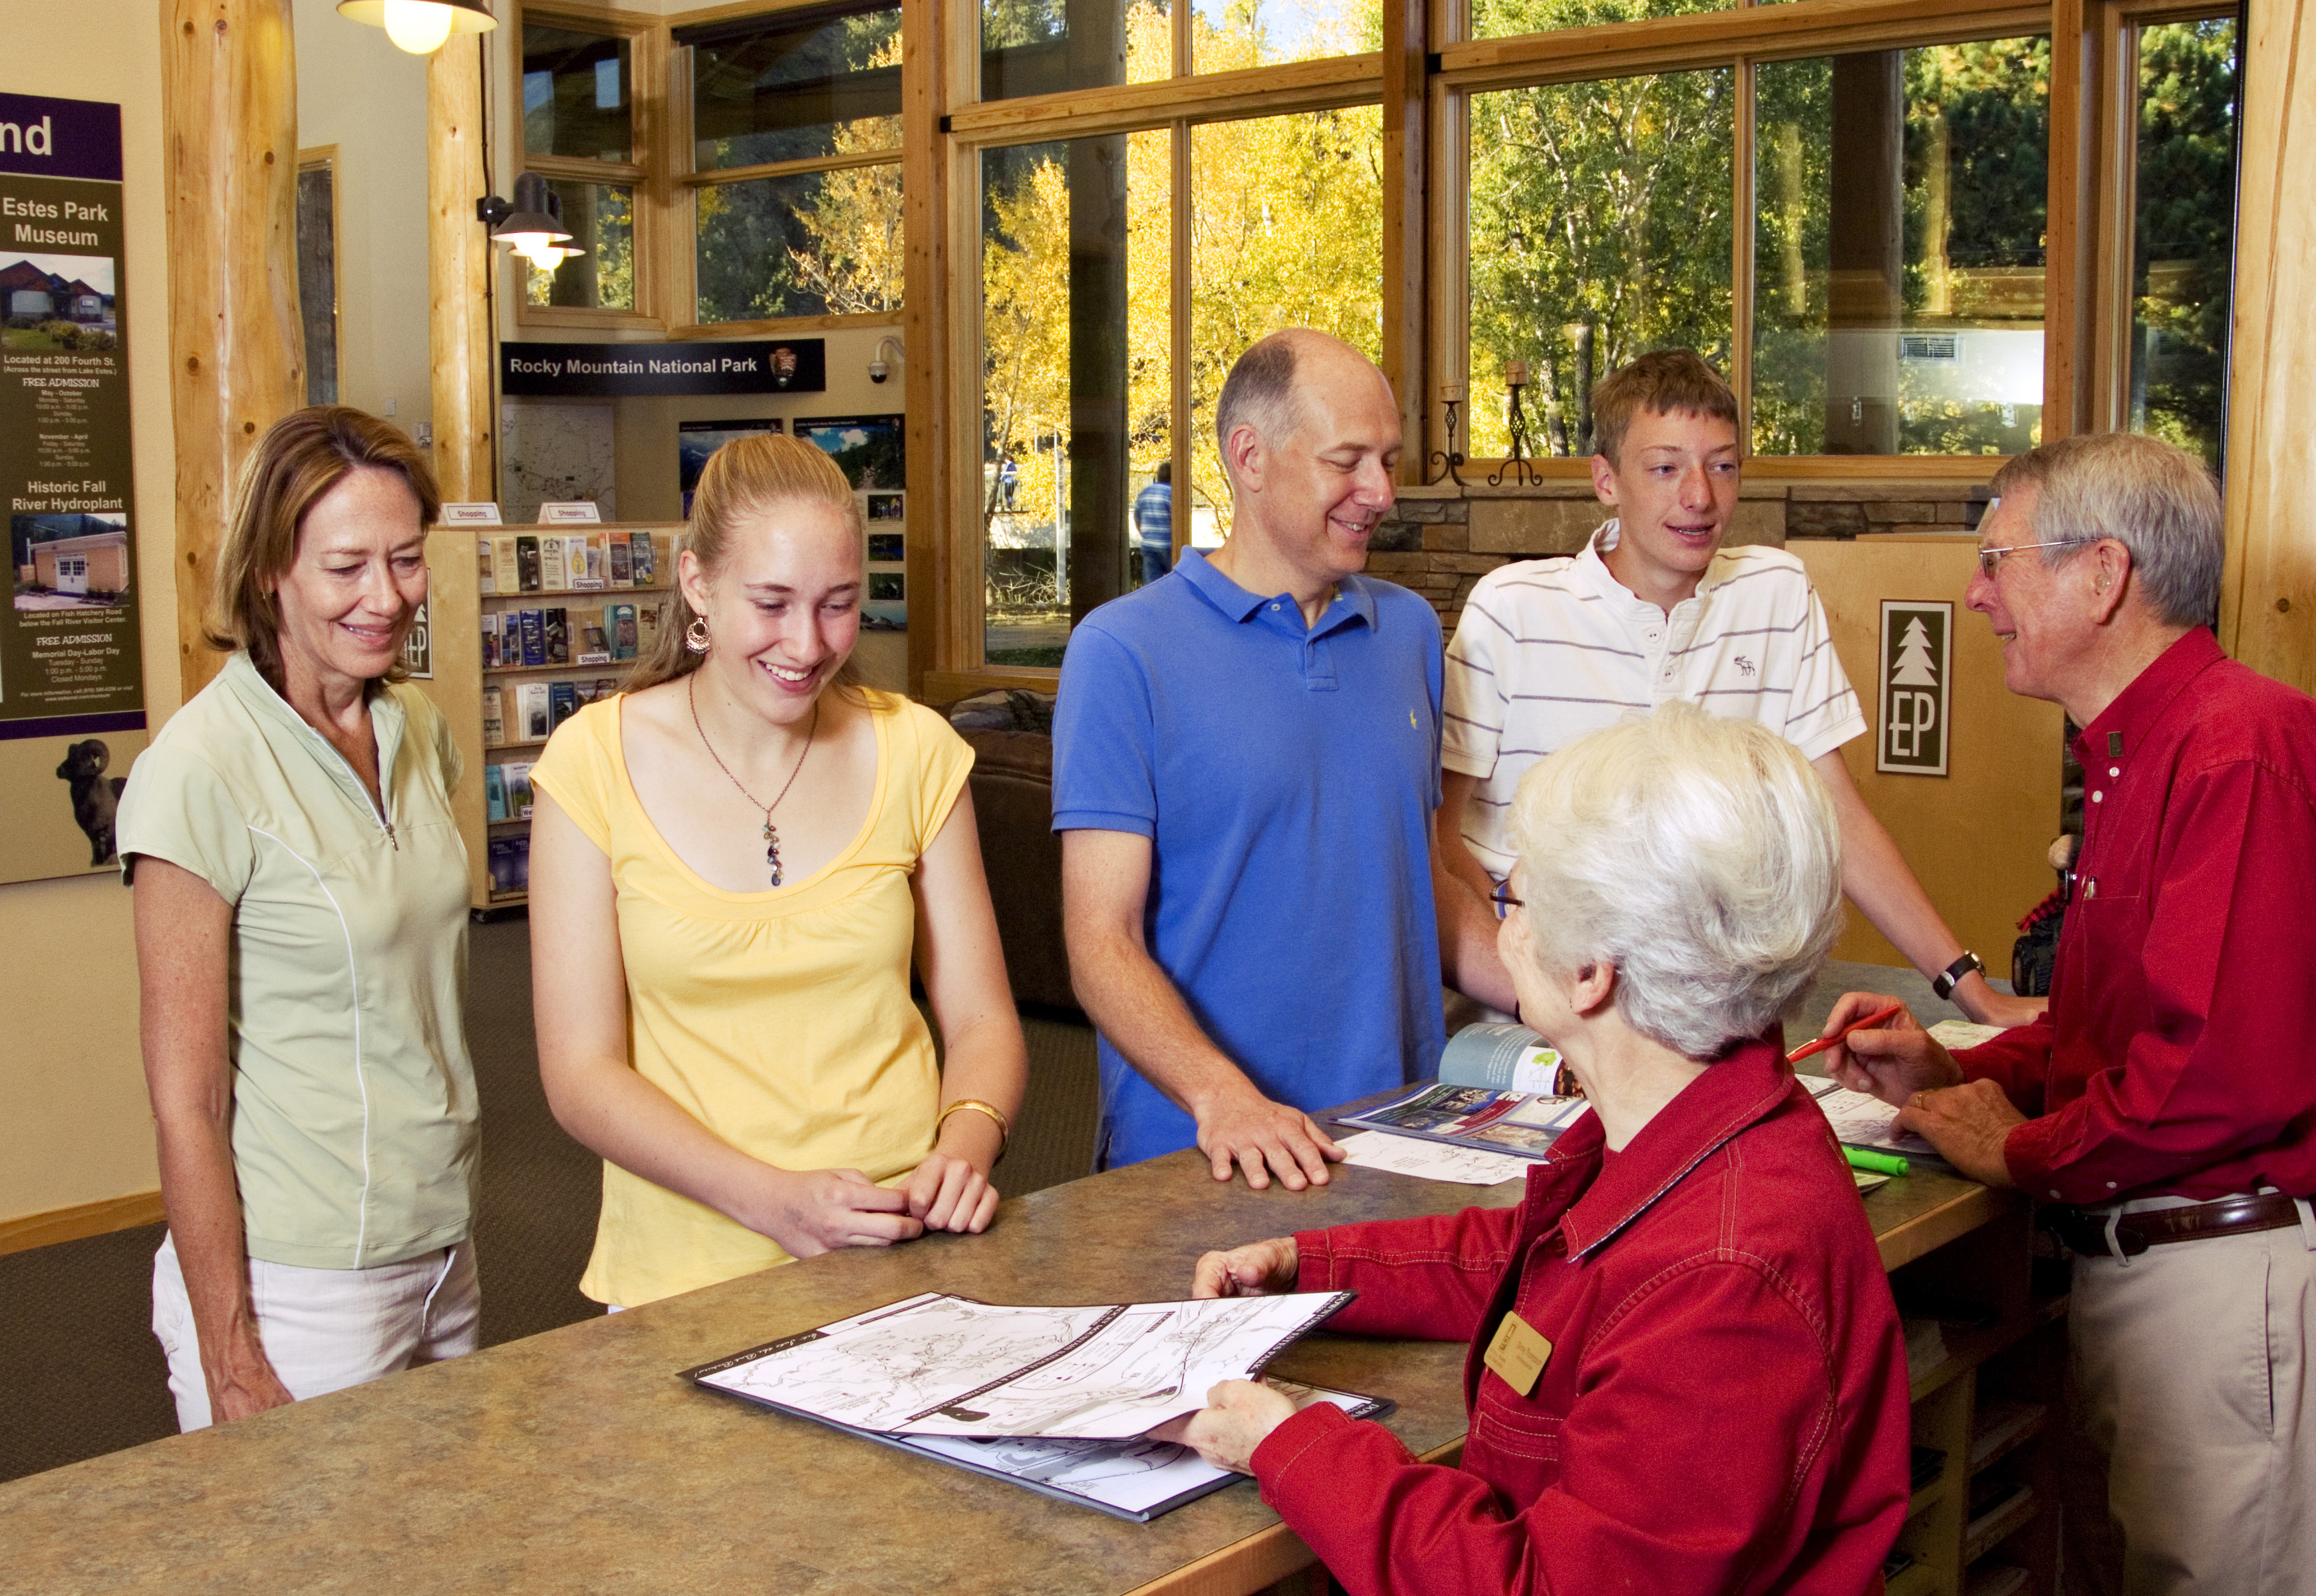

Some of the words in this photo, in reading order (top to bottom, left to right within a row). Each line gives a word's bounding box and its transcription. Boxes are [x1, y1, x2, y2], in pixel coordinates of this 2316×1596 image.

[3, 197, 58, 217] Estes
[65, 201, 108, 221] Park
[15, 223, 98, 246] Museum
[4, 355, 41, 364] Located
[72, 356, 101, 366] Fourth
[509, 358, 561, 376] Rocky
[566, 359, 644, 375] Mountain
[648, 358, 716, 374] National
[721, 358, 758, 372] Park
[23, 378, 47, 387] FREE
[49, 378, 99, 388] ADMISSION
[28, 481, 79, 493] Historic
[82, 481, 106, 493] Fall
[13, 499, 47, 511] River
[51, 497, 122, 512] Hydroplant
[576, 581, 603, 589] Shopping
[37, 636, 60, 646] FREE
[62, 634, 112, 644] ADMISSION
[68, 648, 104, 657] Day-Labor
[581, 654, 607, 664] Shopping
[1888, 691, 1936, 757] EP
[1298, 1293, 1350, 1331] DOWNTOWN
[1273, 1331, 1300, 1350] ESTES
[1250, 1350, 1276, 1370] PARK
